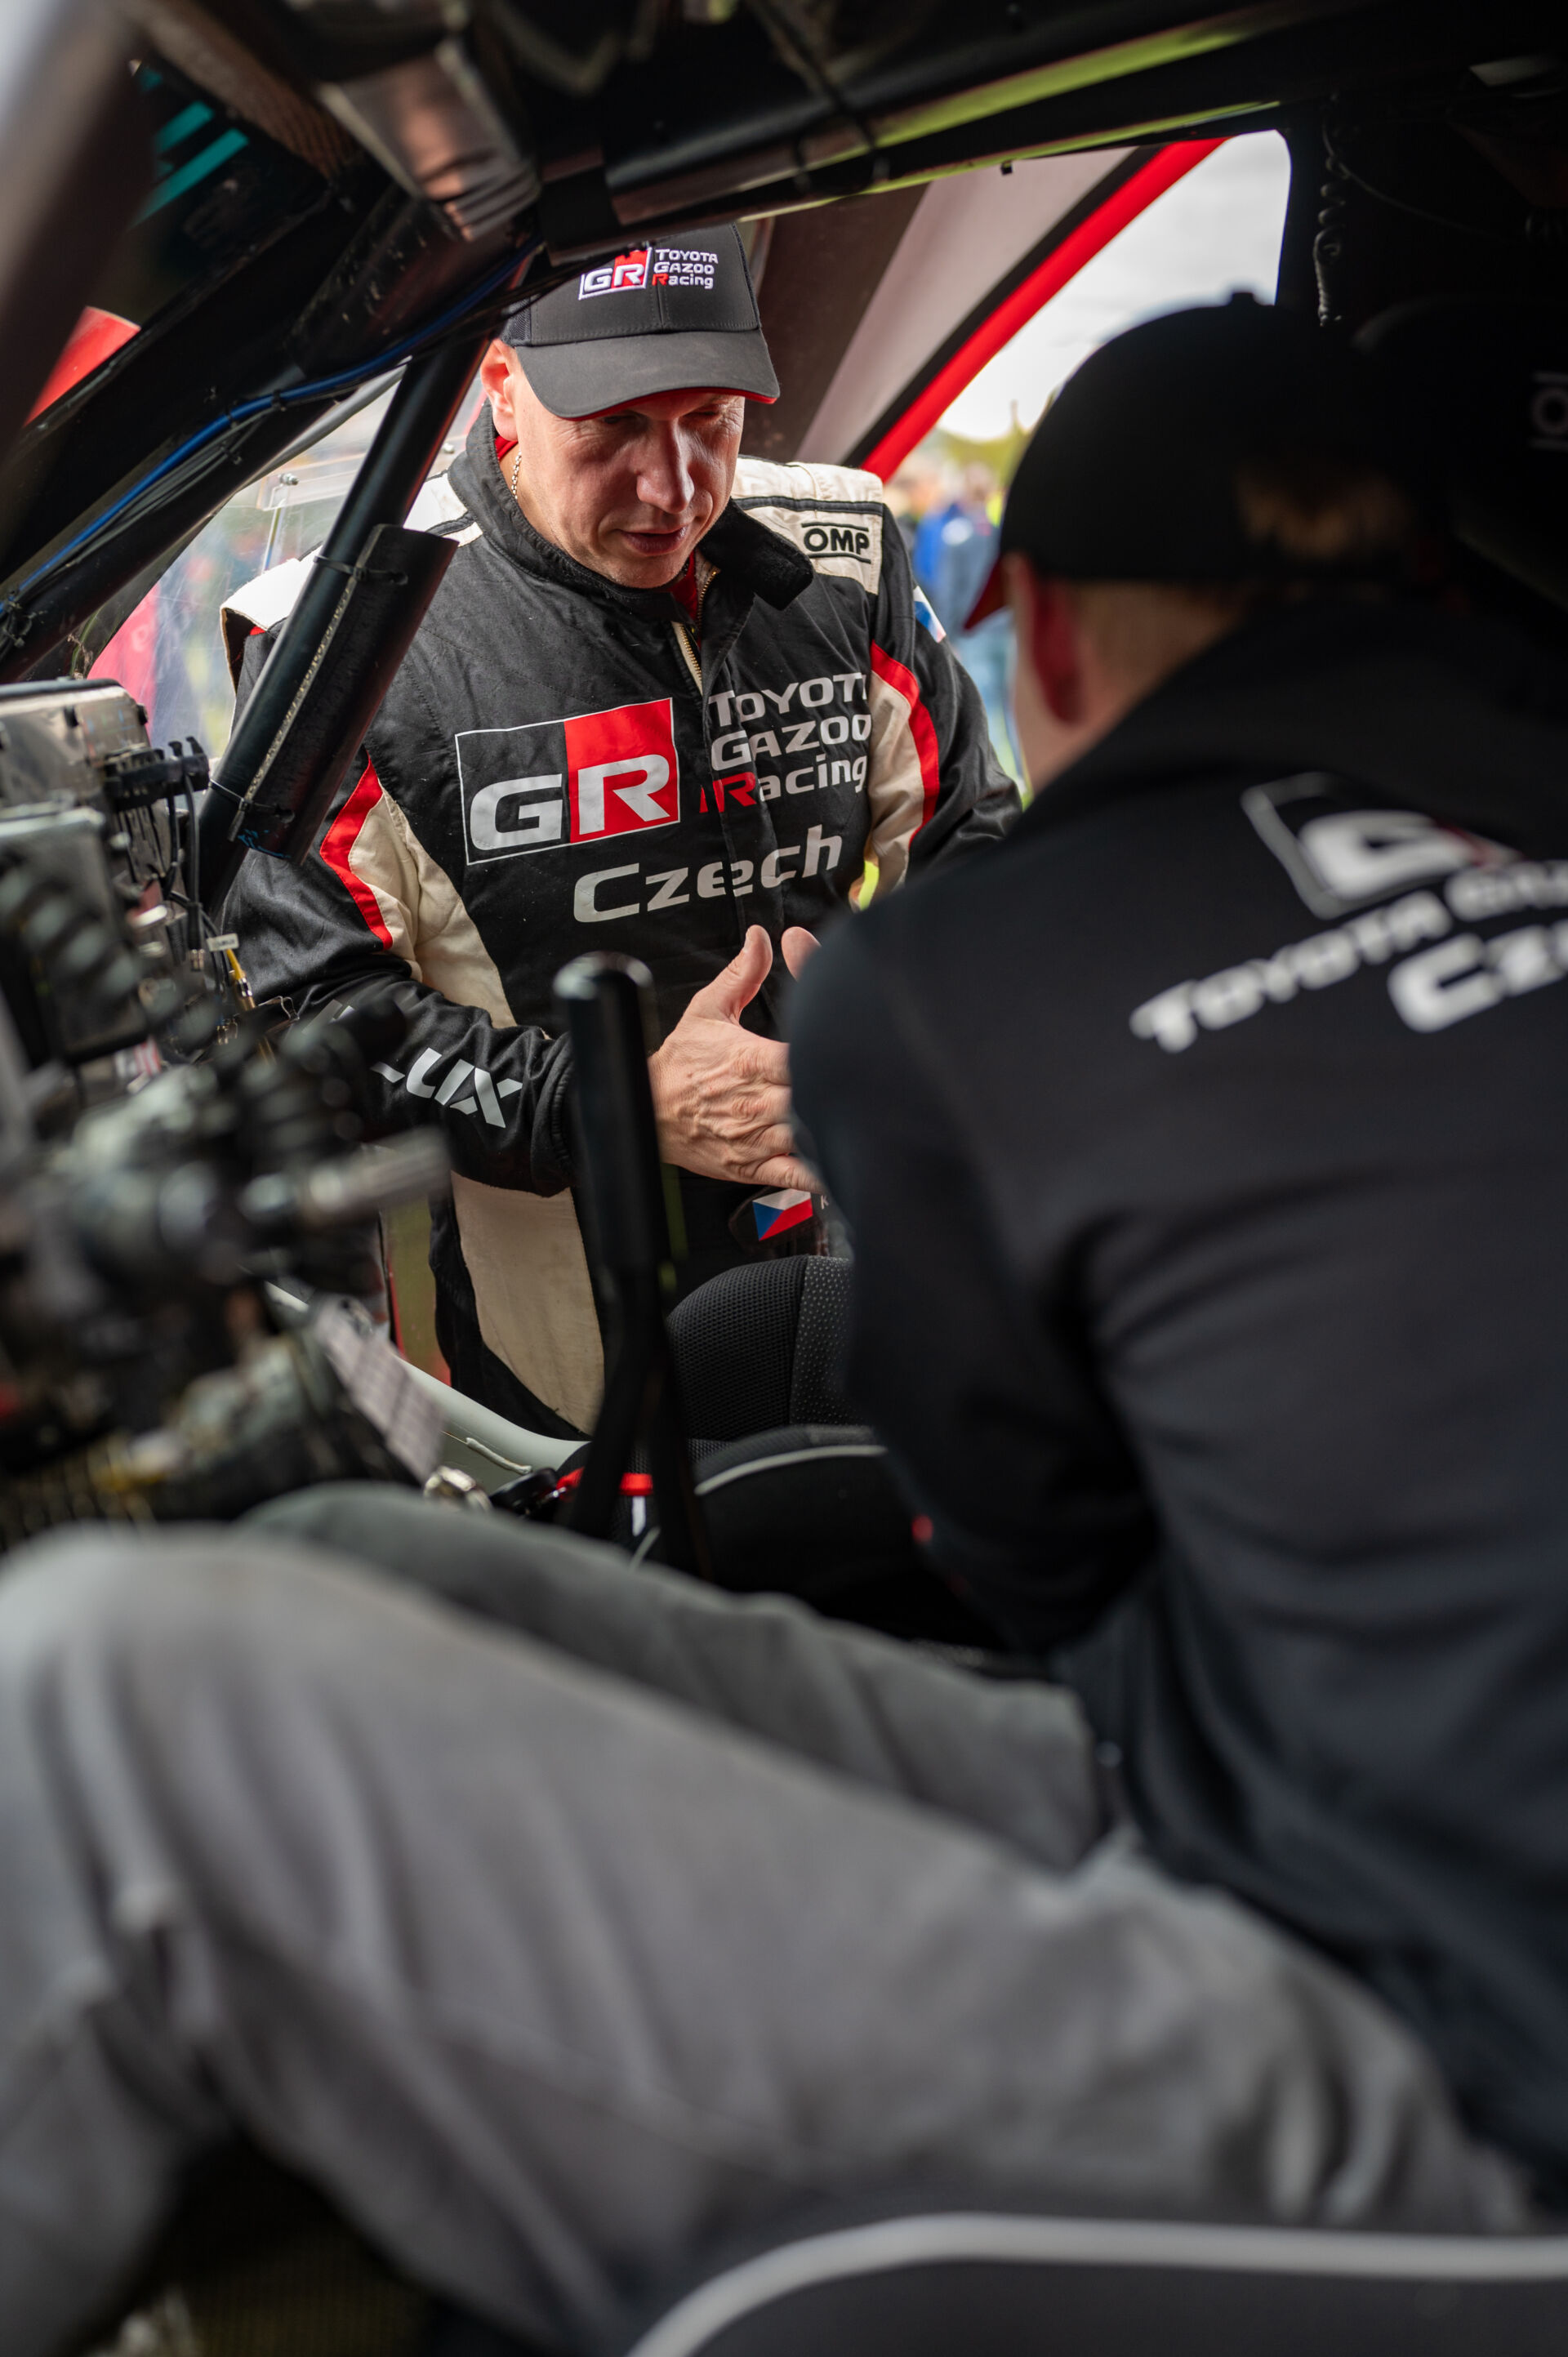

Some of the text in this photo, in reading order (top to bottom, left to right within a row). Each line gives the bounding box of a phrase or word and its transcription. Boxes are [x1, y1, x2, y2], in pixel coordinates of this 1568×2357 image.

[653, 261, 715, 274] GAZOO
[655, 248, 719, 264] TOYOTA
[584, 263, 645, 292] GR
[652, 273, 714, 290] Racing
[804, 528, 870, 555] OMP
[710, 714, 872, 771] GAZOO
[700, 755, 868, 813] Racing
[470, 753, 670, 851] GR
[573, 823, 843, 923] Czech
